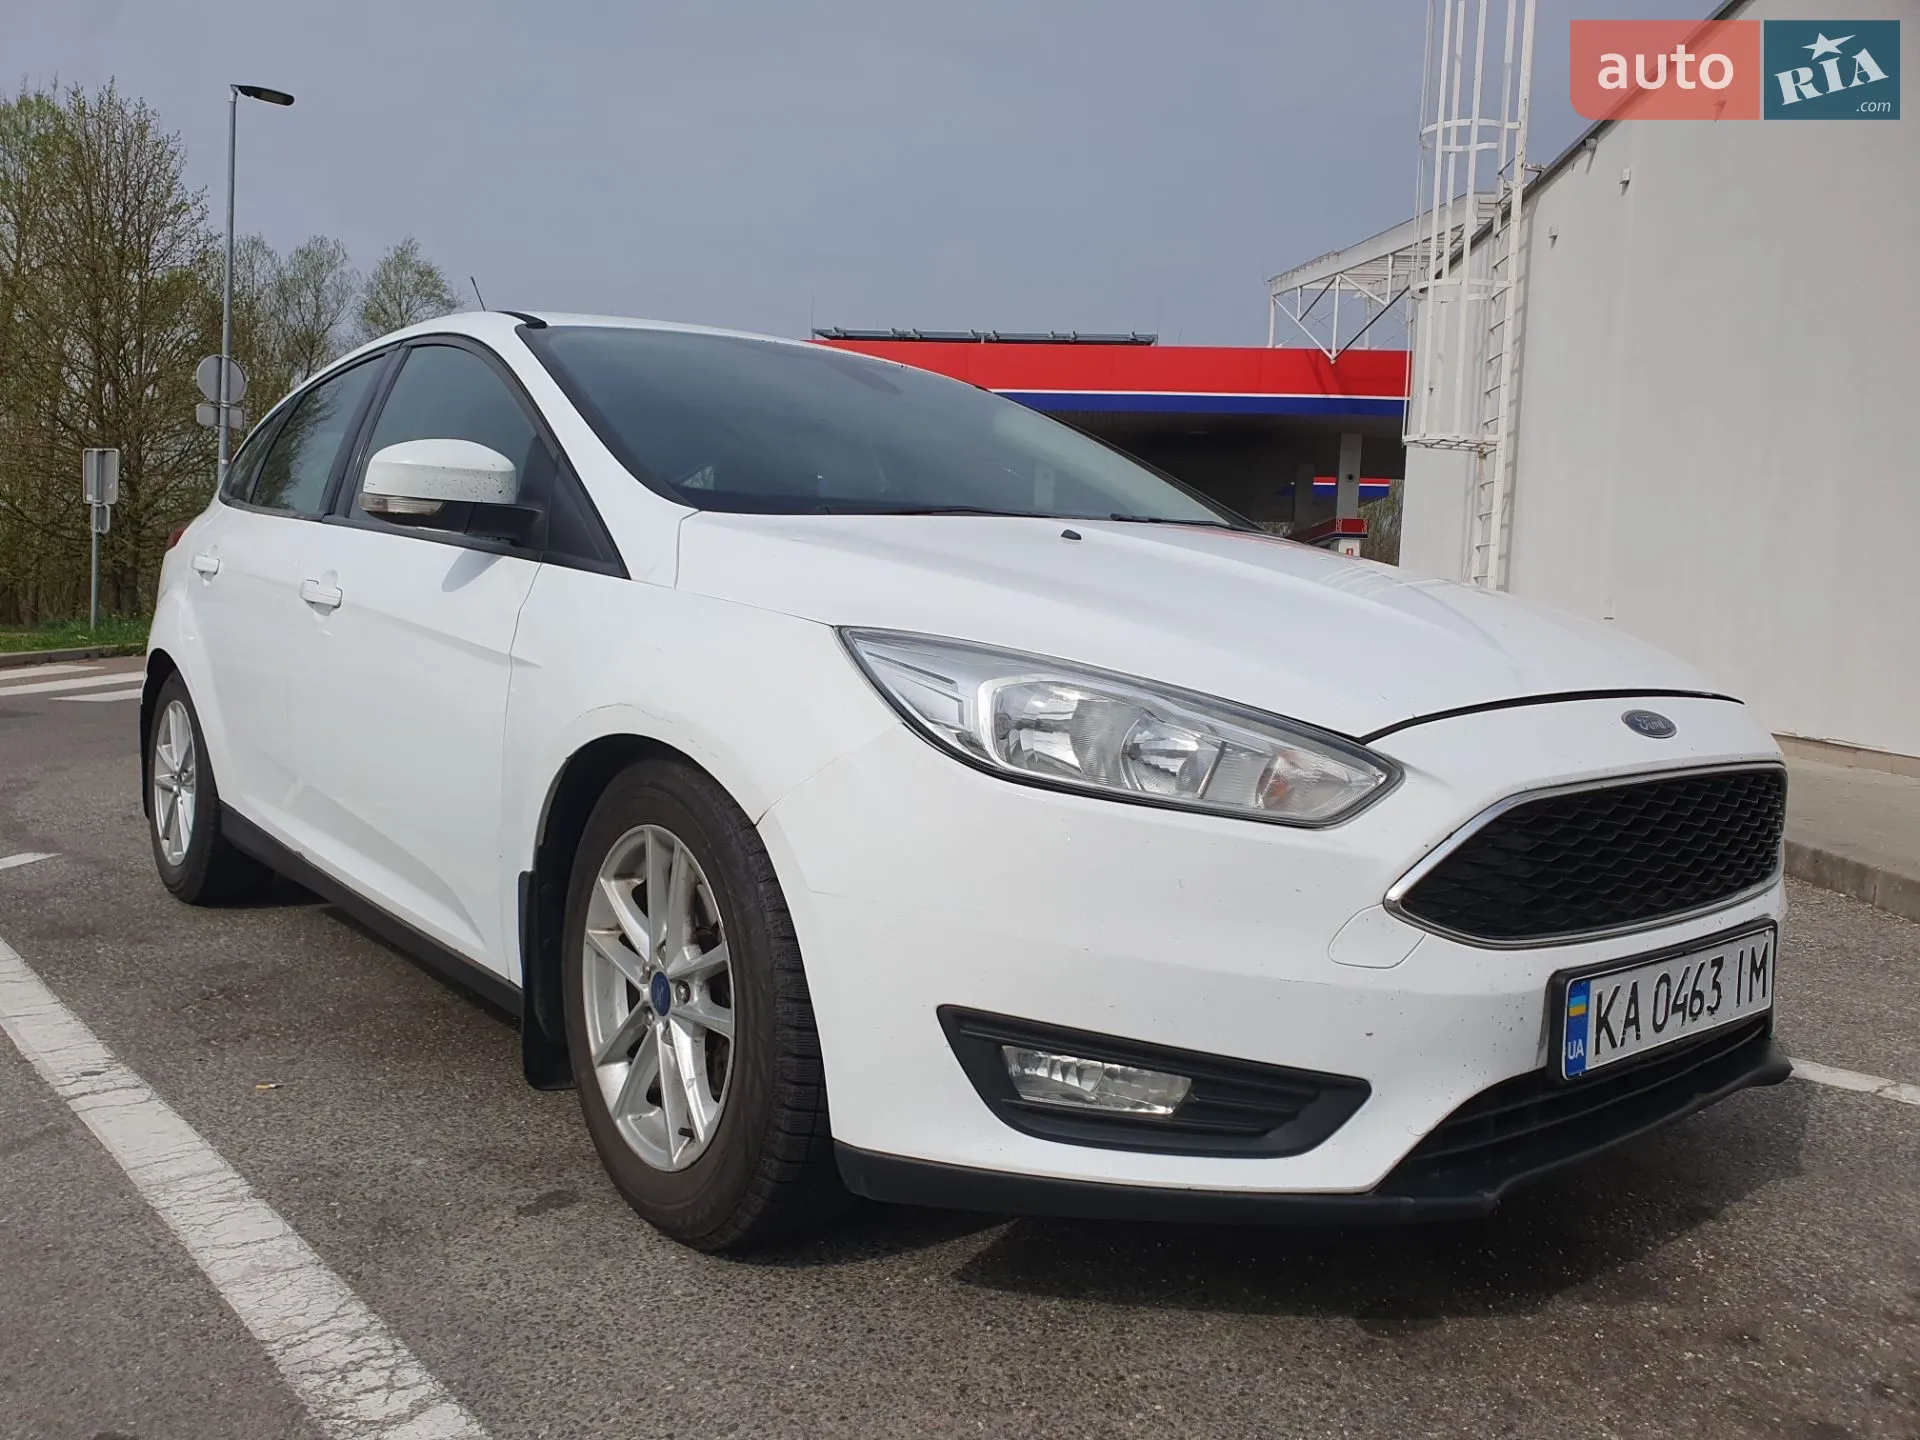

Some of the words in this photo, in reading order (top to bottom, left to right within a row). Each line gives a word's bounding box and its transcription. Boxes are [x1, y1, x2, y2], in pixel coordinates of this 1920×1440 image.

[1634, 714, 1668, 731] Ford
[1595, 980, 1641, 1056] KA
[1652, 955, 1724, 1033] 0463
[1736, 942, 1769, 1008] IM
[1567, 1040, 1585, 1060] UA
